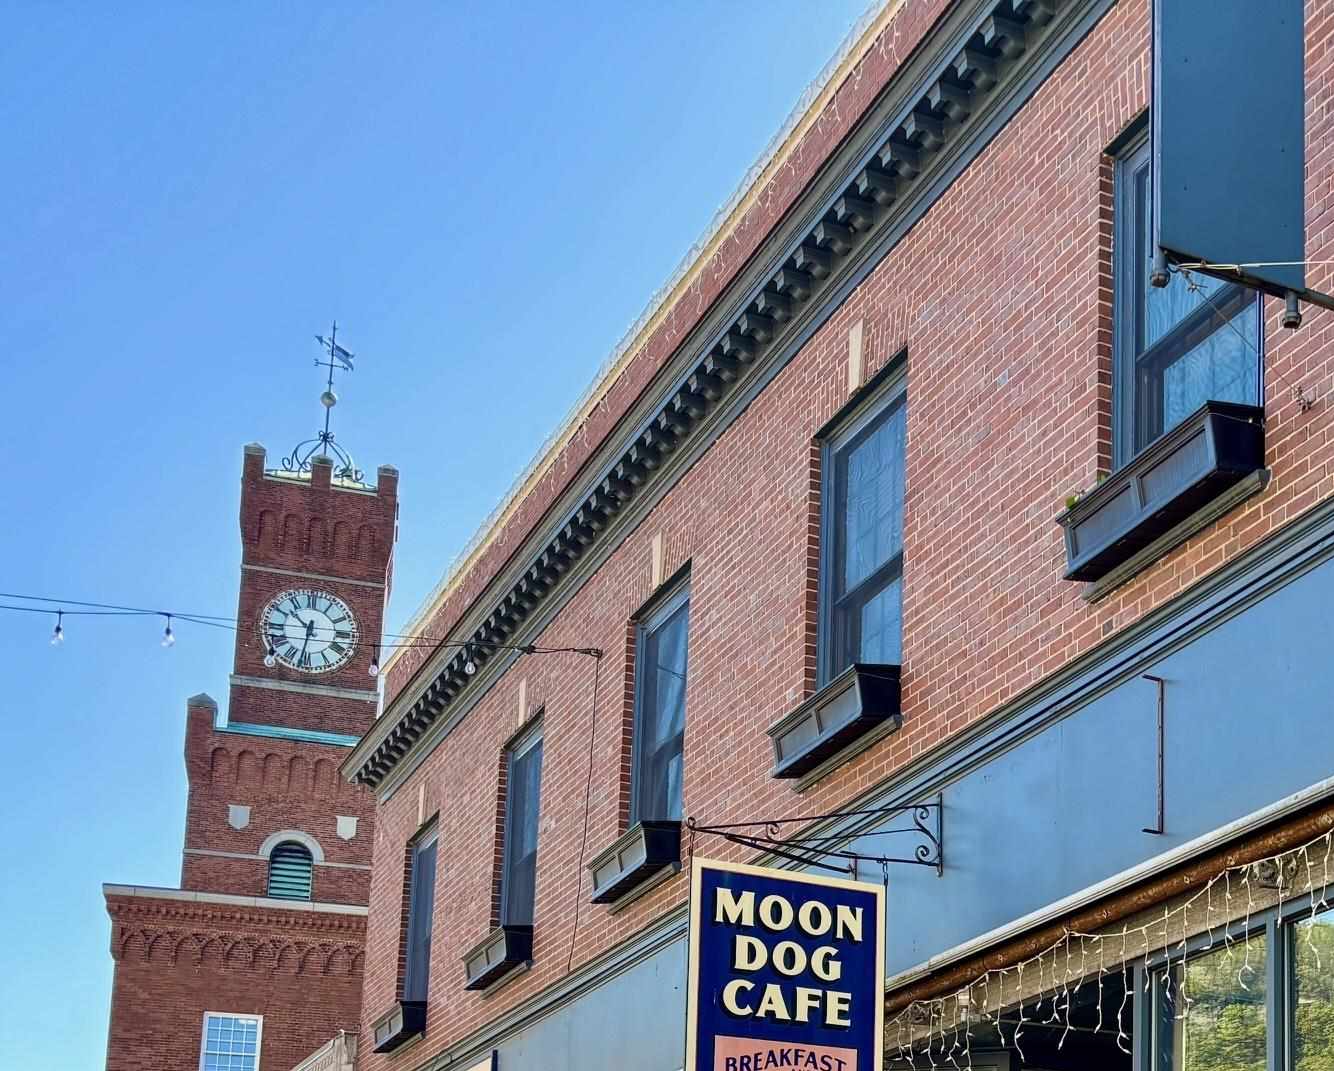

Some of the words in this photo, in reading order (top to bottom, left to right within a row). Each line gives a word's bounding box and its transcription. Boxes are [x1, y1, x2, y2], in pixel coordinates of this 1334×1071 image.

[714, 886, 864, 942] MOON
[734, 934, 842, 982] DOG
[722, 979, 852, 1027] CAFE
